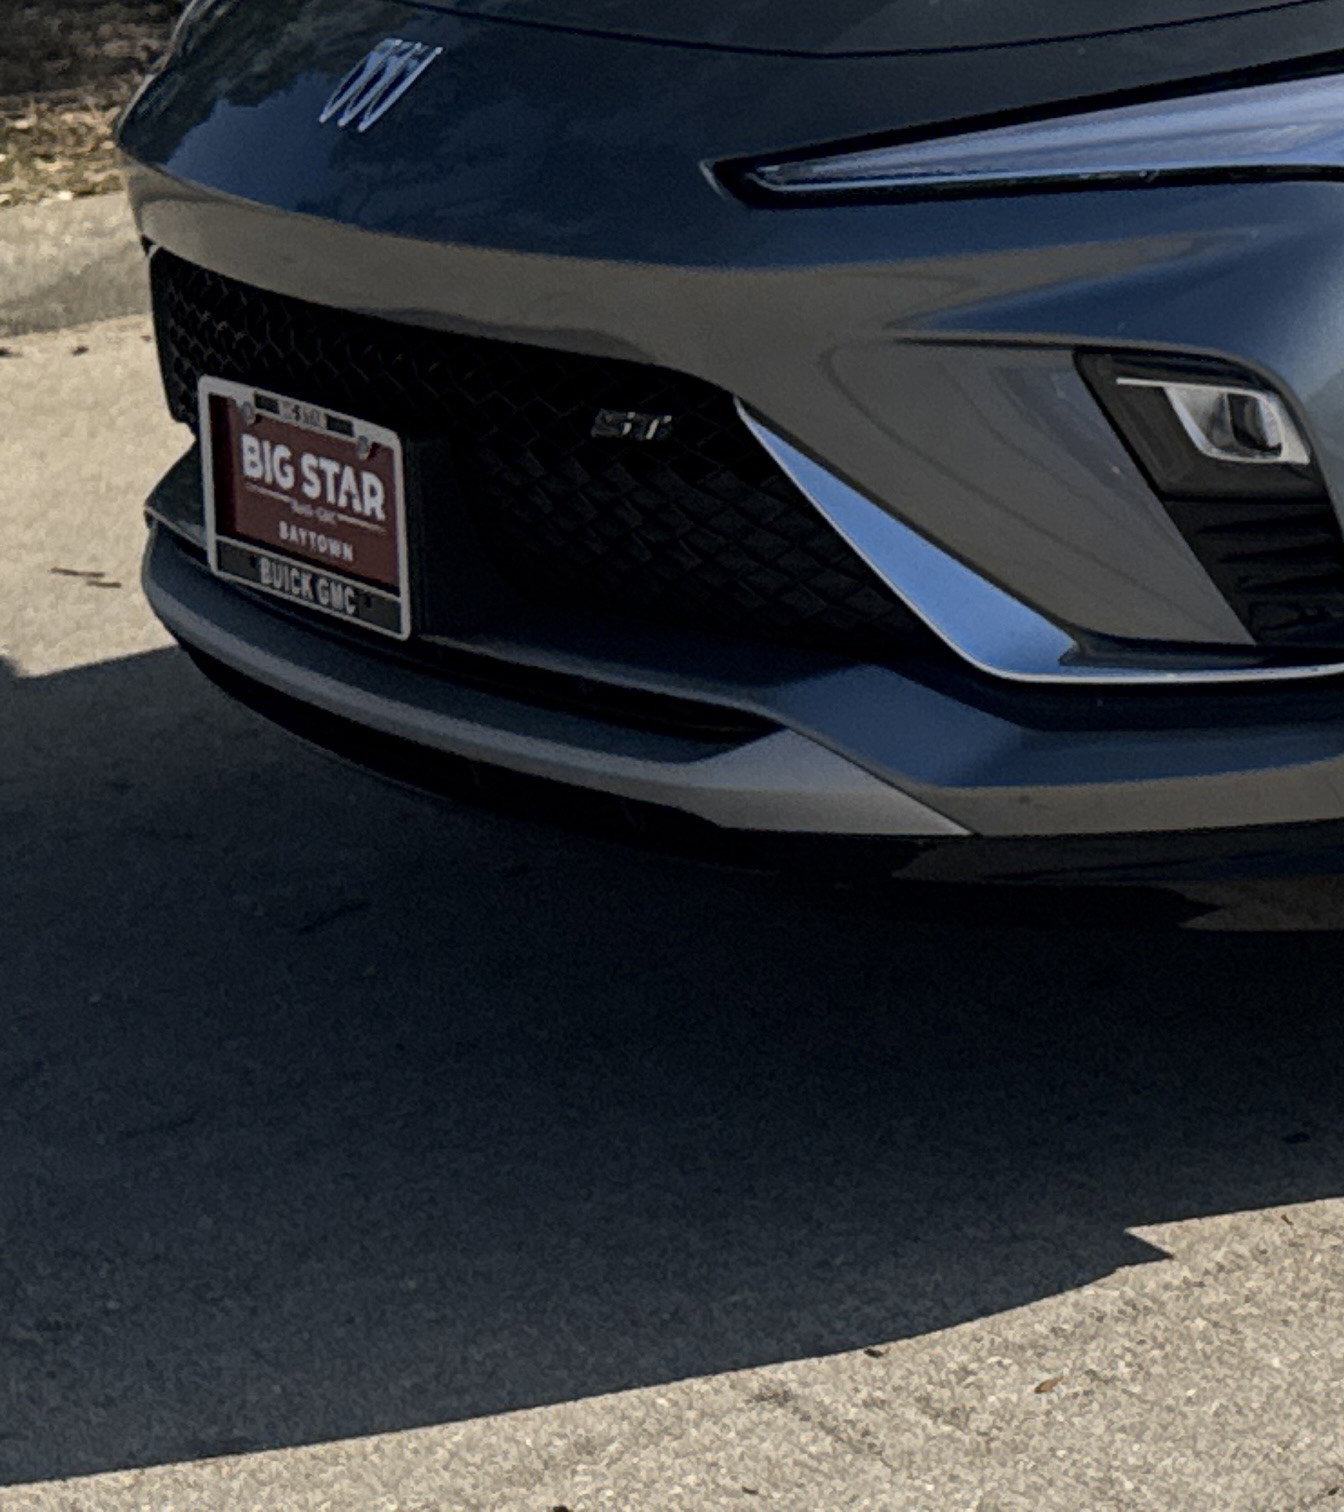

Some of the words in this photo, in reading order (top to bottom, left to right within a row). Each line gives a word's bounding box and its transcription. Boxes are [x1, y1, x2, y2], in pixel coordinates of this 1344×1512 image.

[240, 433, 296, 490] BIG
[300, 452, 387, 521] STAR
[277, 519, 355, 561] BAYTOWN
[260, 556, 313, 601] BUICK
[314, 577, 357, 616] GMC
